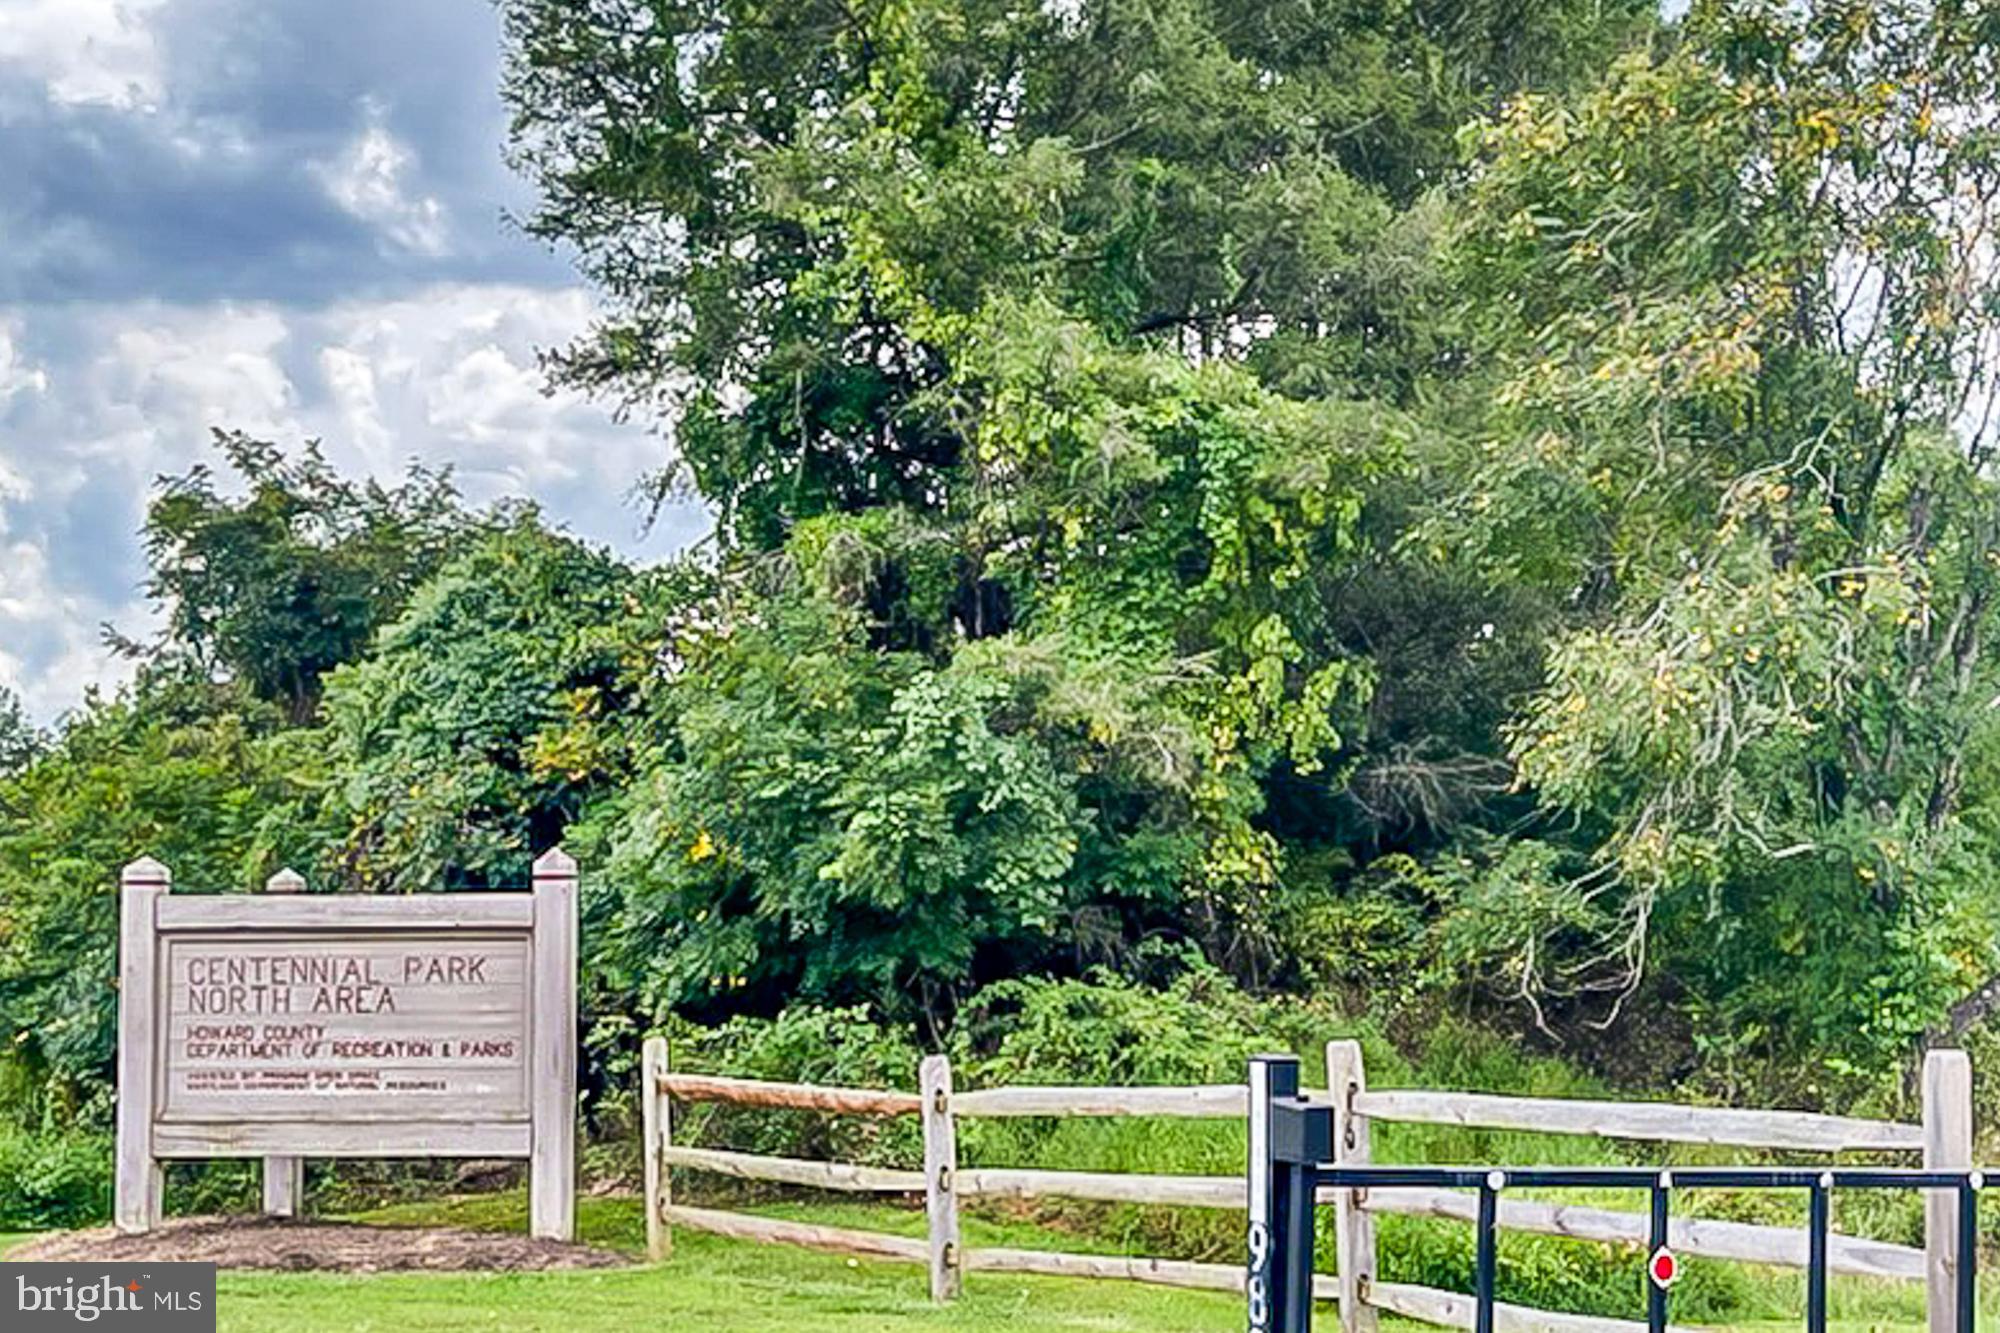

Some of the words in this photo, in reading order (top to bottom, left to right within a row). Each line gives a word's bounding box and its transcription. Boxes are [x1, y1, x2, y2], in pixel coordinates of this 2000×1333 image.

[188, 957, 380, 986] CENTENNIAL
[403, 956, 487, 984] PARK
[188, 986, 291, 1014] NORTH
[313, 986, 397, 1014] AREA
[187, 1025, 254, 1041] HOWARD
[264, 1025, 326, 1041] COUNTY
[187, 1043, 292, 1058] DEPARTMENT
[302, 1042, 322, 1058] OF
[333, 1041, 432, 1058] RECREATION
[461, 1041, 514, 1057] PARKS
[1248, 1221, 1268, 1333] 98
